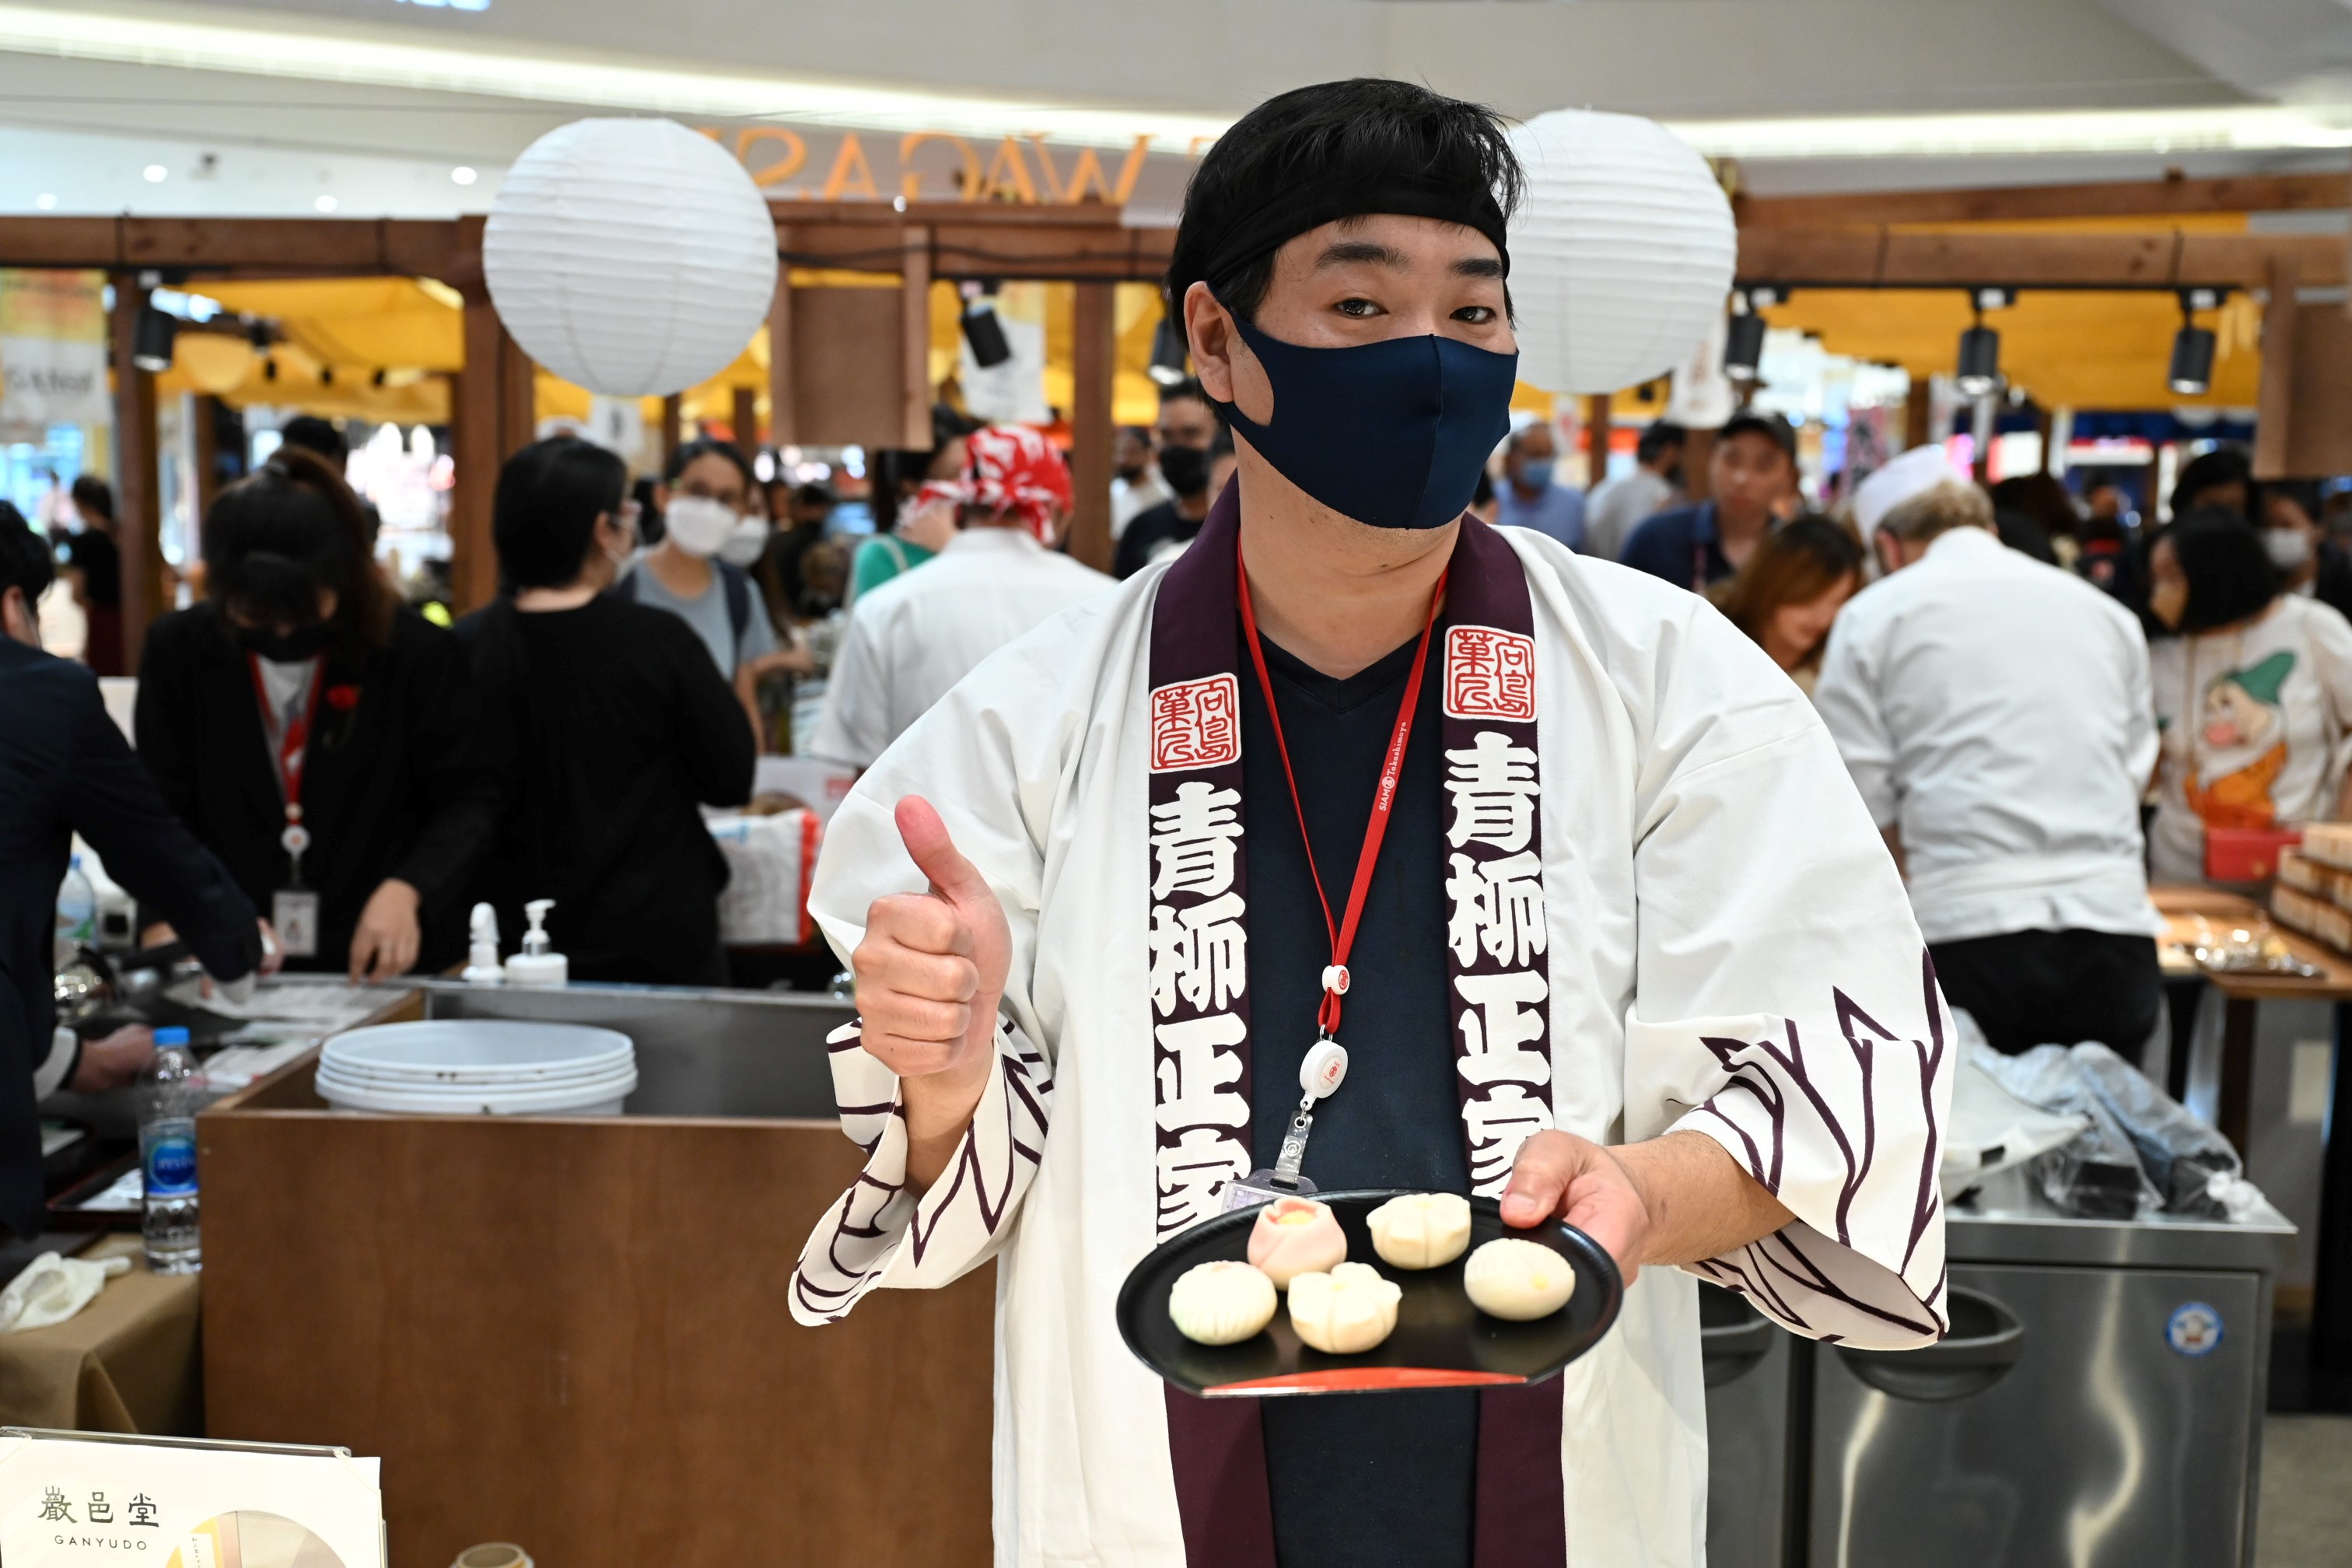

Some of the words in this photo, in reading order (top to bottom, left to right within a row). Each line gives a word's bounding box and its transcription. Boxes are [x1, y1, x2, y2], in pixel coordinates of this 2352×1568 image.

[1378, 789, 1392, 812] SIAM
[1386, 721, 1407, 776] Takashimaya
[54, 1535, 147, 1551] GANYUDO
